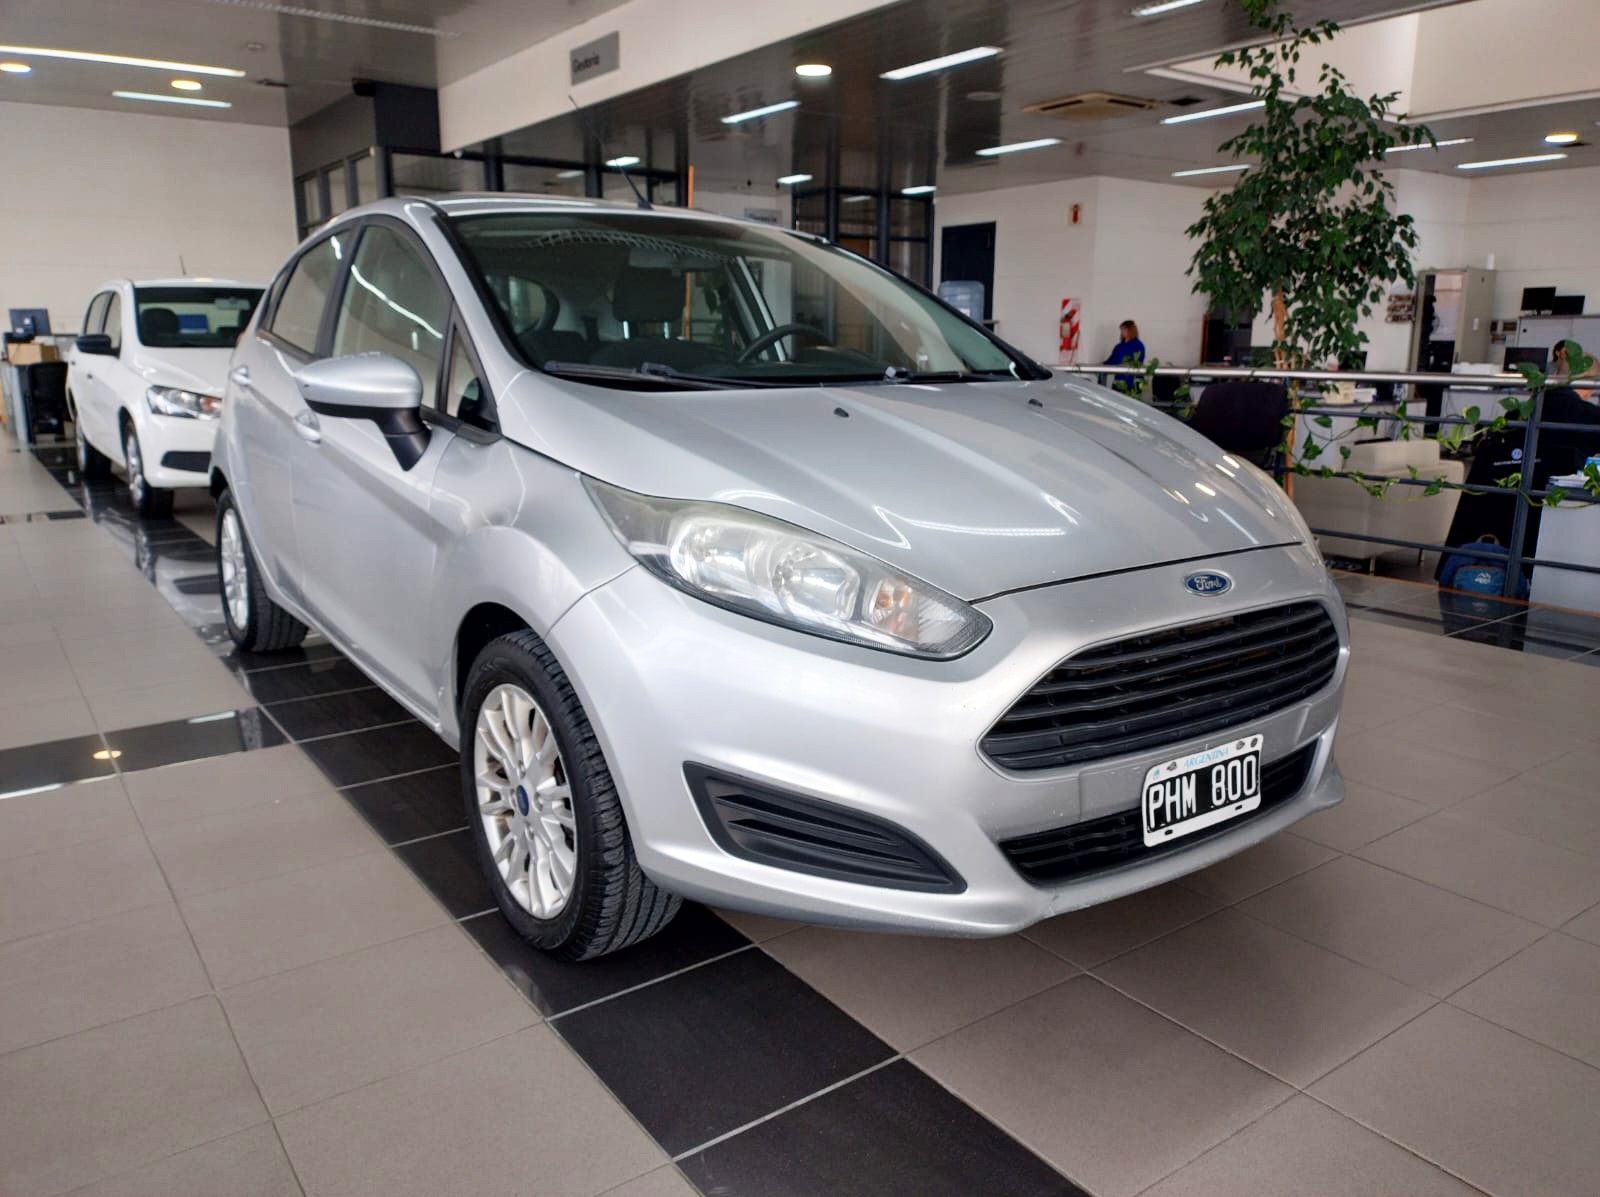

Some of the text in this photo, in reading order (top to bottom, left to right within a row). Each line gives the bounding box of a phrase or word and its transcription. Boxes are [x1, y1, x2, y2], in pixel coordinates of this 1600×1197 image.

[1194, 576, 1223, 591] Ford
[1183, 747, 1229, 769] ARGENTINA
[1149, 754, 1257, 829] PHM 800
